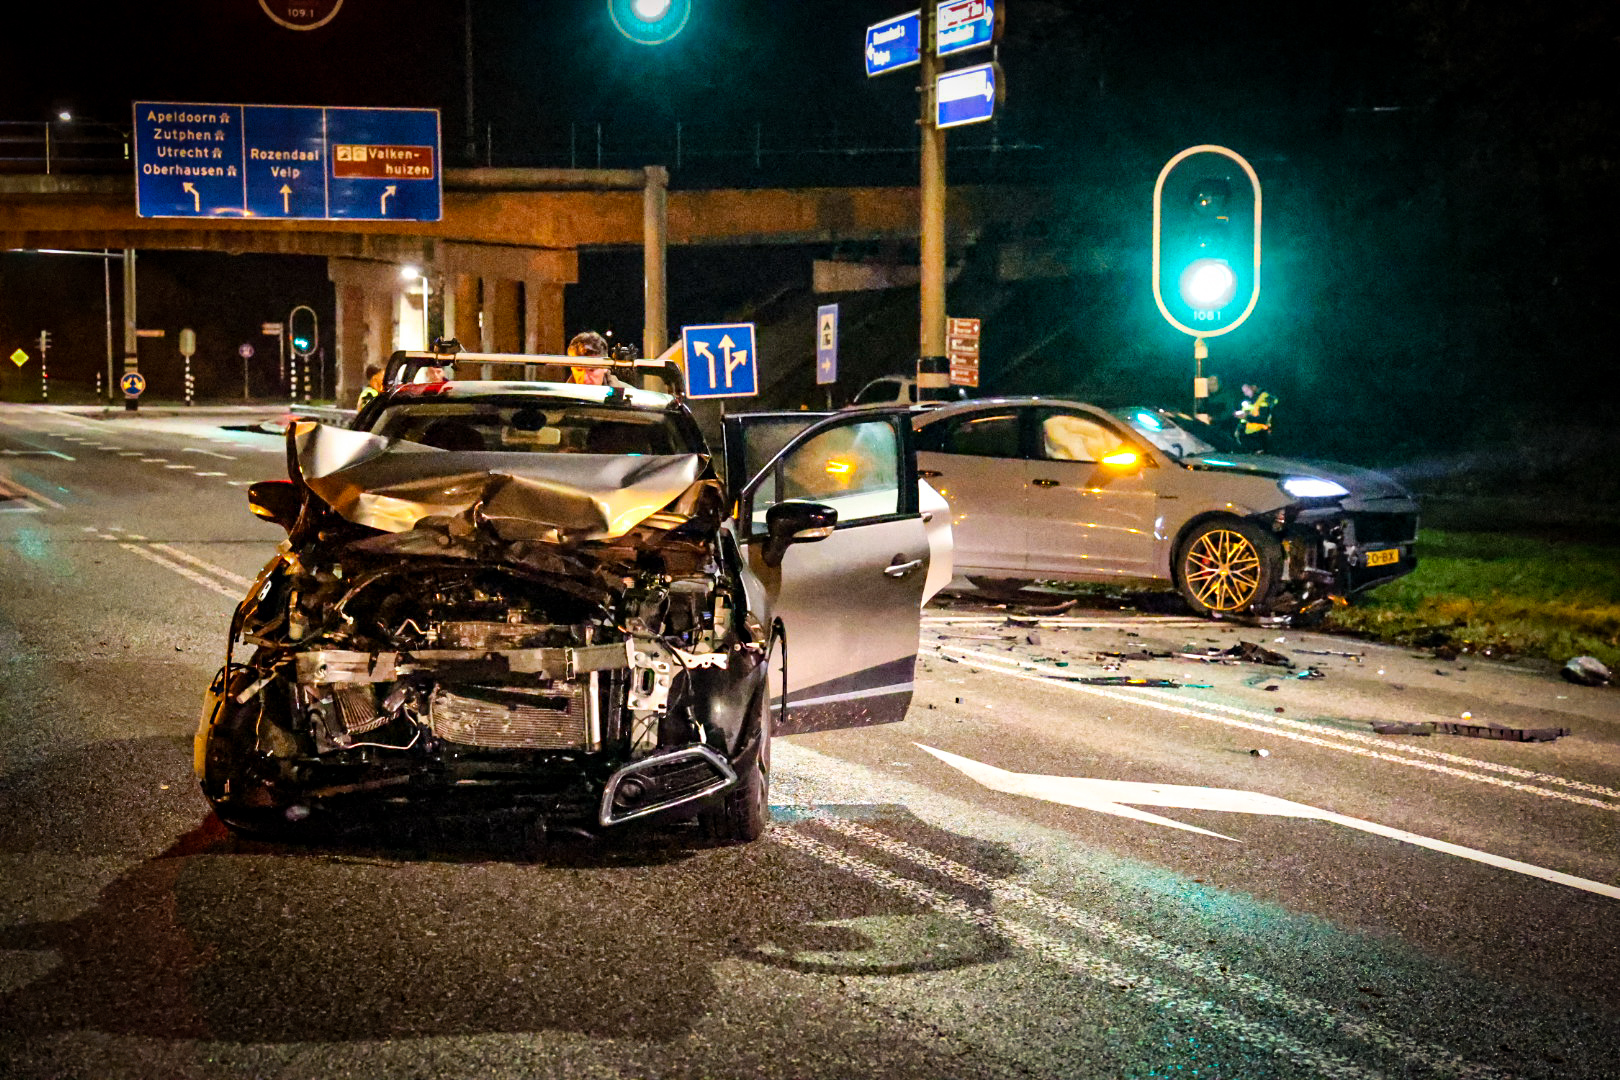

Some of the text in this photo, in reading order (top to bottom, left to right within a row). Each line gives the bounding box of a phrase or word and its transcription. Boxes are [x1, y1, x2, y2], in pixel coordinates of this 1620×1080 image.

[147, 110, 217, 124] Apeldoorn
[153, 128, 212, 142] Zutphen
[156, 146, 209, 159] Utrecht
[250, 147, 320, 161] Rozendaal
[142, 163, 224, 177] Oberhausen
[270, 166, 301, 179] Velp
[385, 164, 430, 176] huizen
